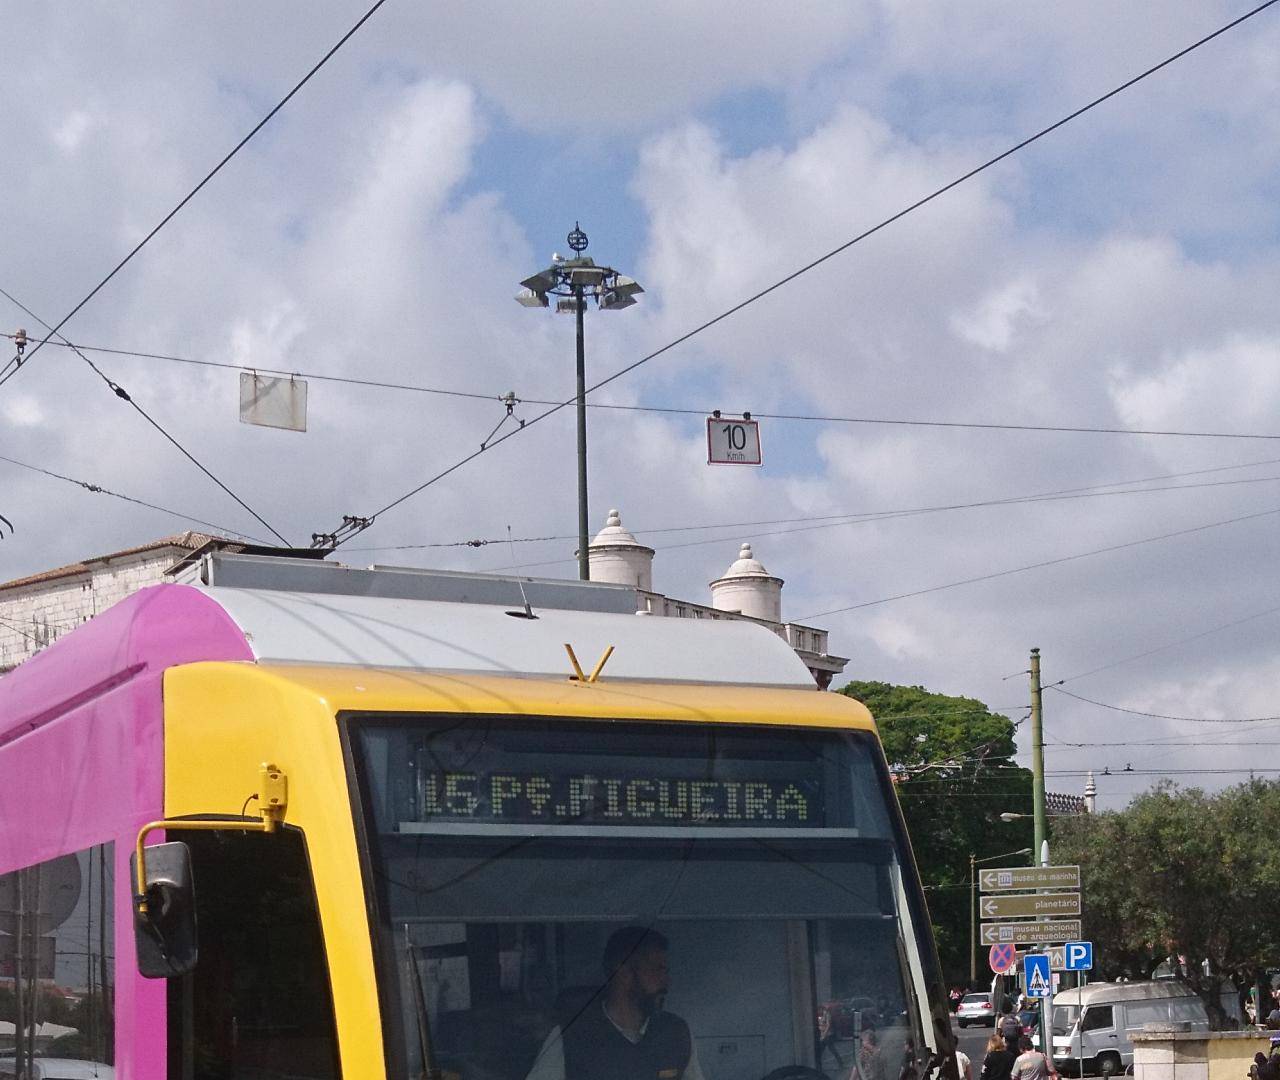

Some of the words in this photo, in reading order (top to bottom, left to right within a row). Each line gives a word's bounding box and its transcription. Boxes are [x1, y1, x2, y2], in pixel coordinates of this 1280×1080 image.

[722, 424, 746, 450] 10
[1013, 874, 1035, 882] museu
[1038, 873, 1047, 881] da
[1049, 872, 1077, 881] marinha
[1035, 899, 1078, 910] planetário
[1014, 925, 1040, 933] museu
[1043, 923, 1078, 932] nacional
[1016, 933, 1027, 941] de
[1030, 931, 1078, 943] arqueologia
[1070, 945, 1087, 967] P
